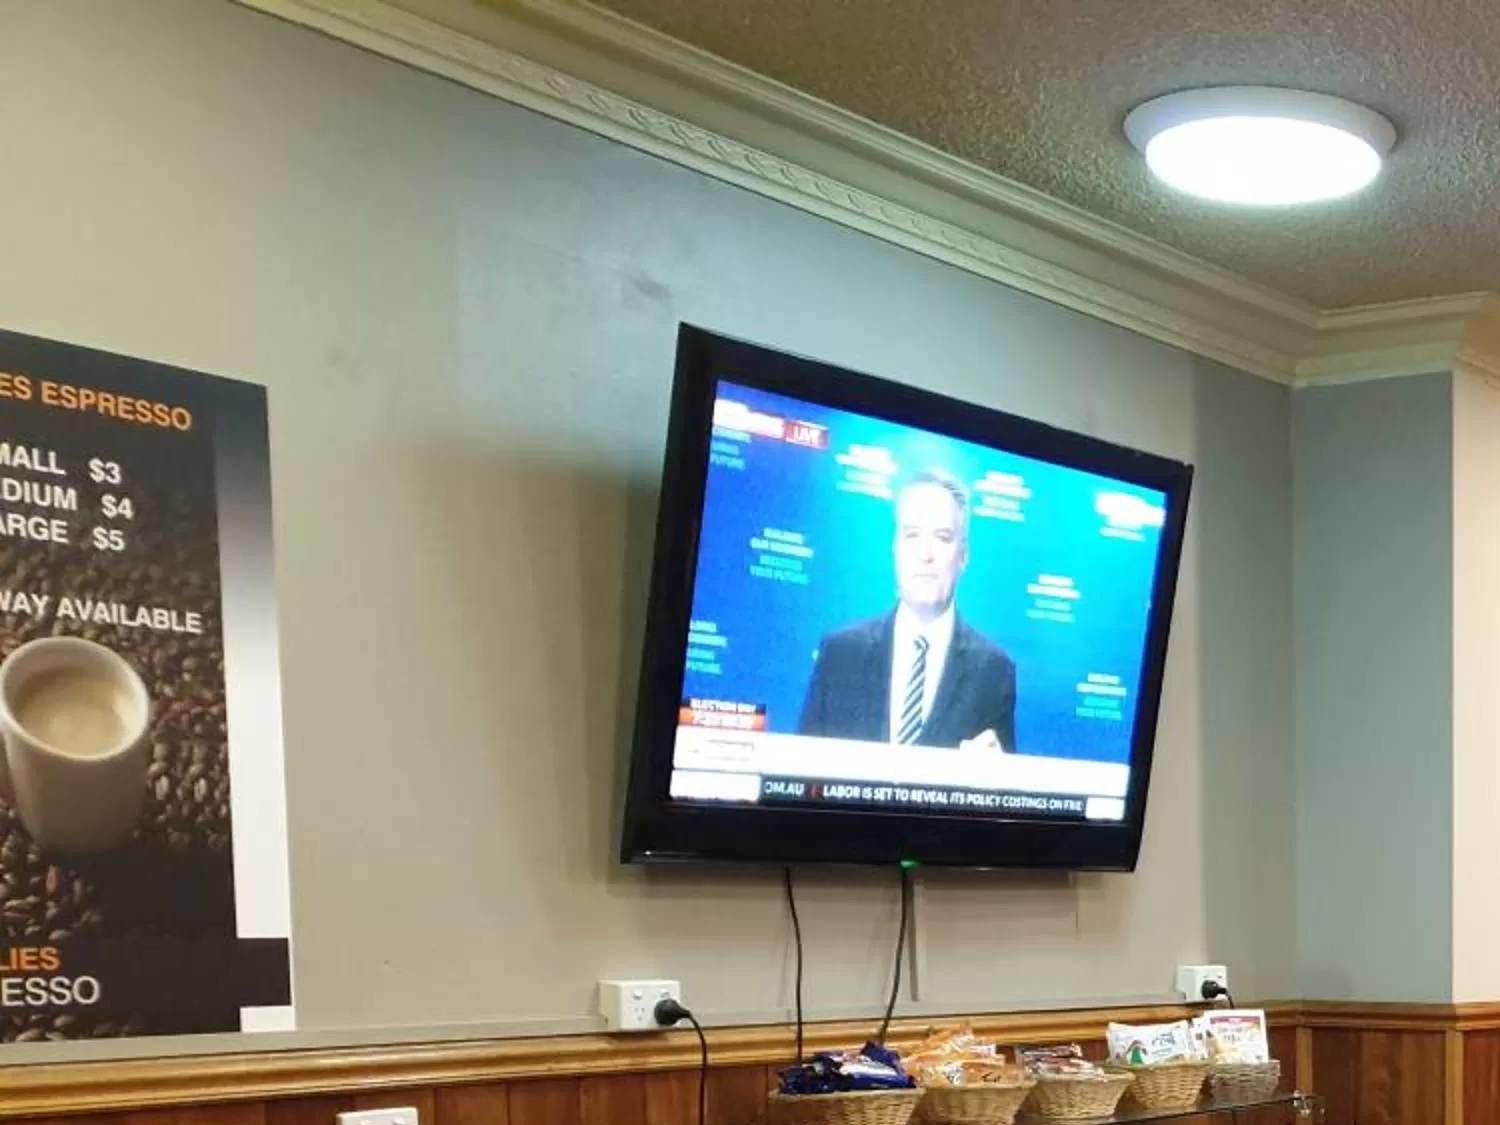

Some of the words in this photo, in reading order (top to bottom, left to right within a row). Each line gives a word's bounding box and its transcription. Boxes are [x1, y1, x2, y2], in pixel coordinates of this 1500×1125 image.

[41, 381, 193, 431] ESPRESSO
[88, 458, 122, 485] $3
[101, 494, 135, 519] $4
[92, 526, 126, 551] $5
[56, 596, 203, 634] AVAILABLE
[823, 784, 860, 799] LABOR
[2, 975, 101, 1007] ESSO
